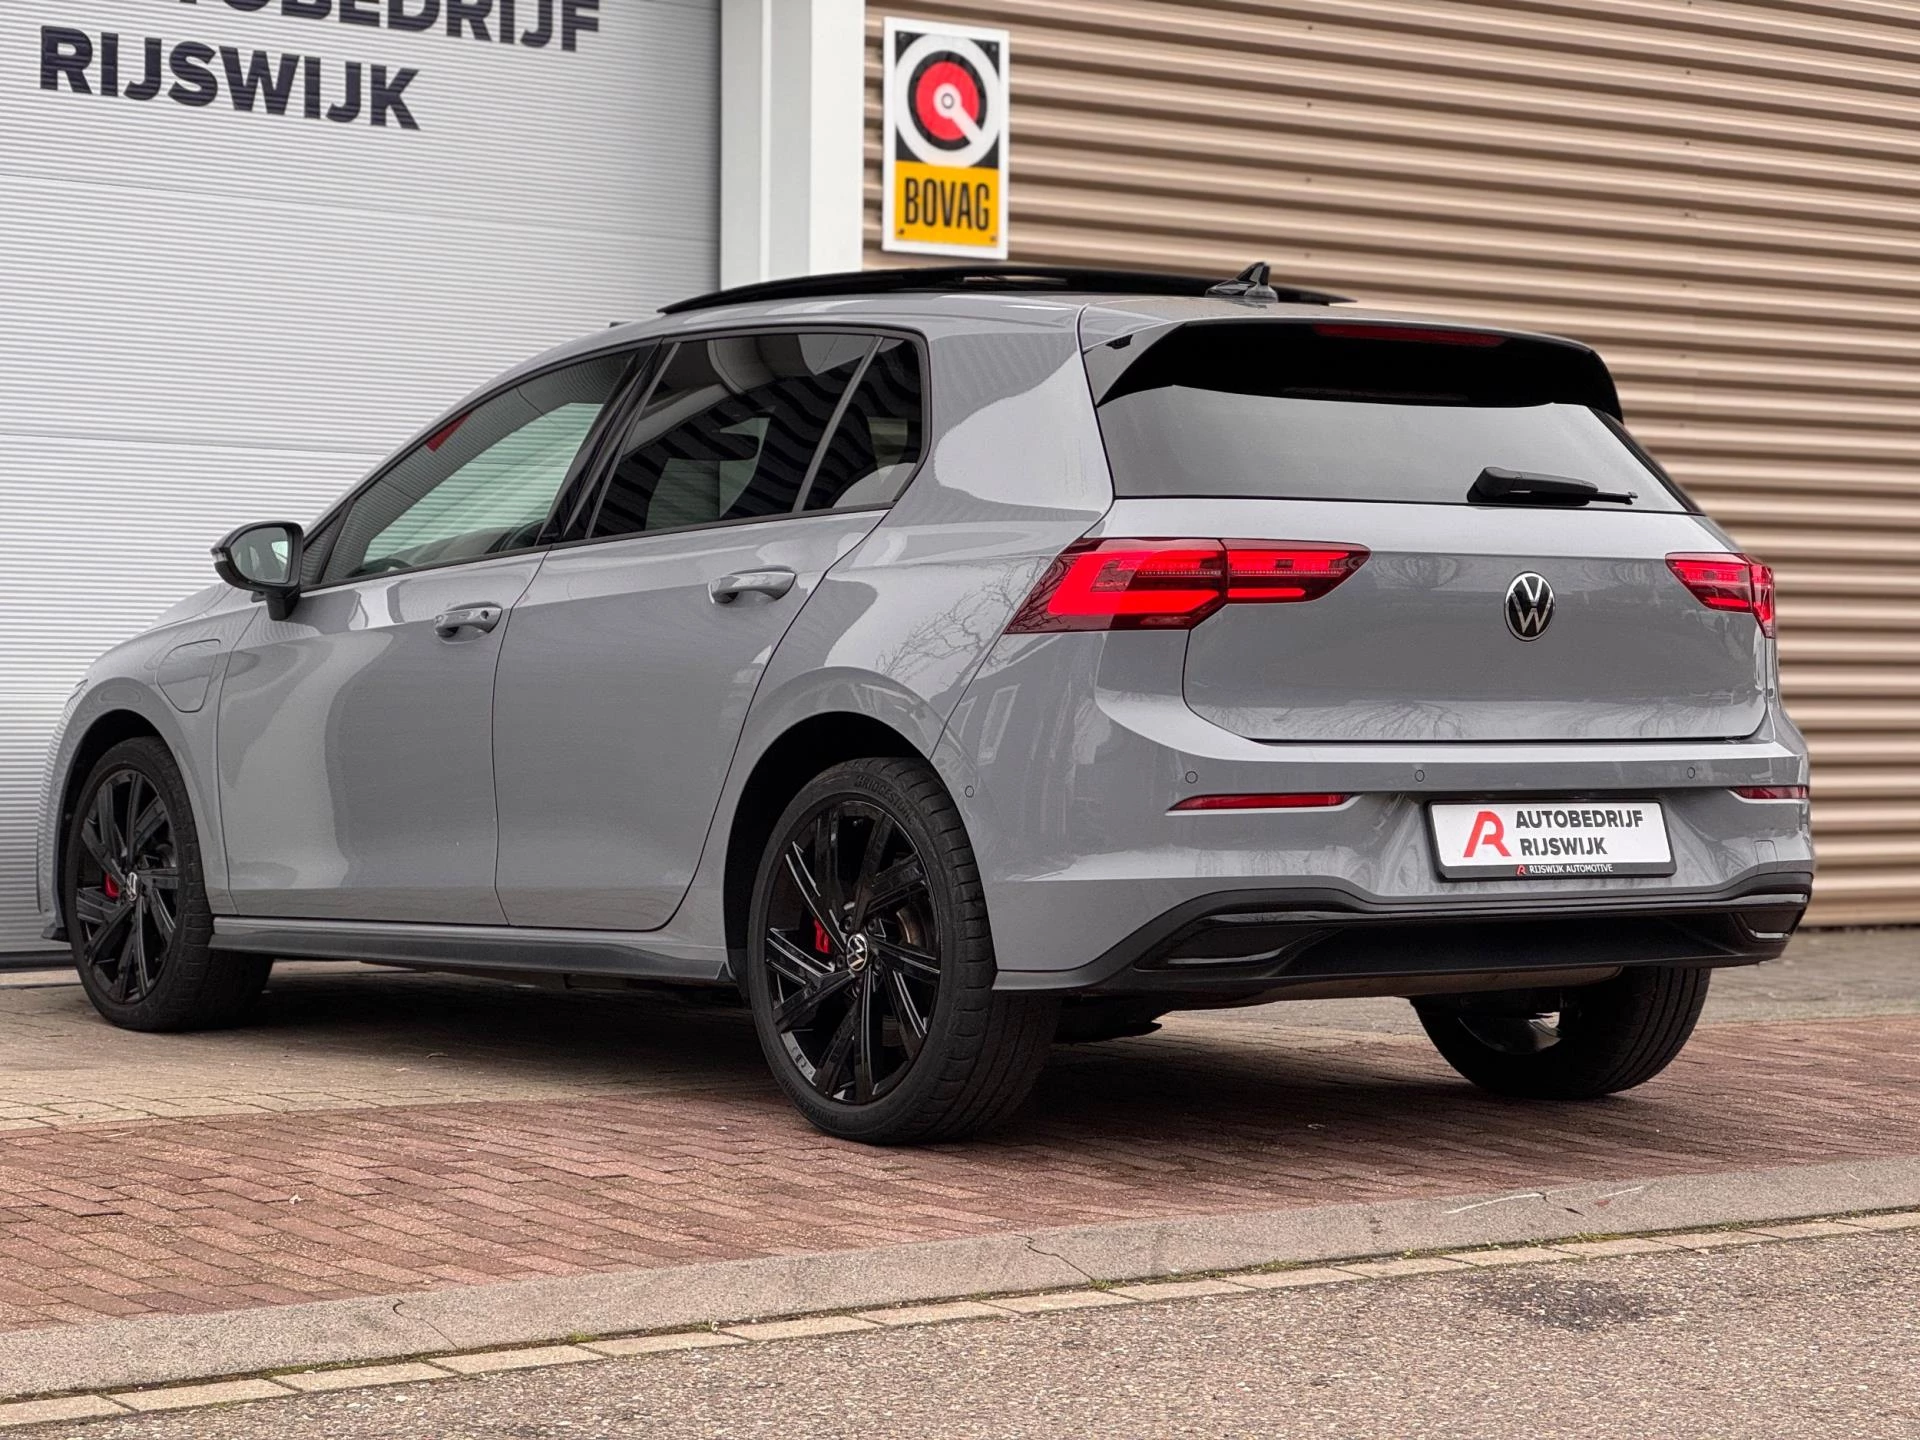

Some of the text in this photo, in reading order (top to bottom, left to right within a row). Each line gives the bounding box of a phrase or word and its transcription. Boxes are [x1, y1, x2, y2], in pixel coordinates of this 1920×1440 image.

[40, 25, 421, 130] RIJSWIJK
[905, 177, 989, 231] BOVAG
[1516, 810, 1643, 828] AUTOBEDRIJF
[1520, 837, 1608, 856] RIJSWIJK
[1529, 864, 1565, 874] RIJSWIJK
[1566, 863, 1613, 873] AUTOMOTIVE
